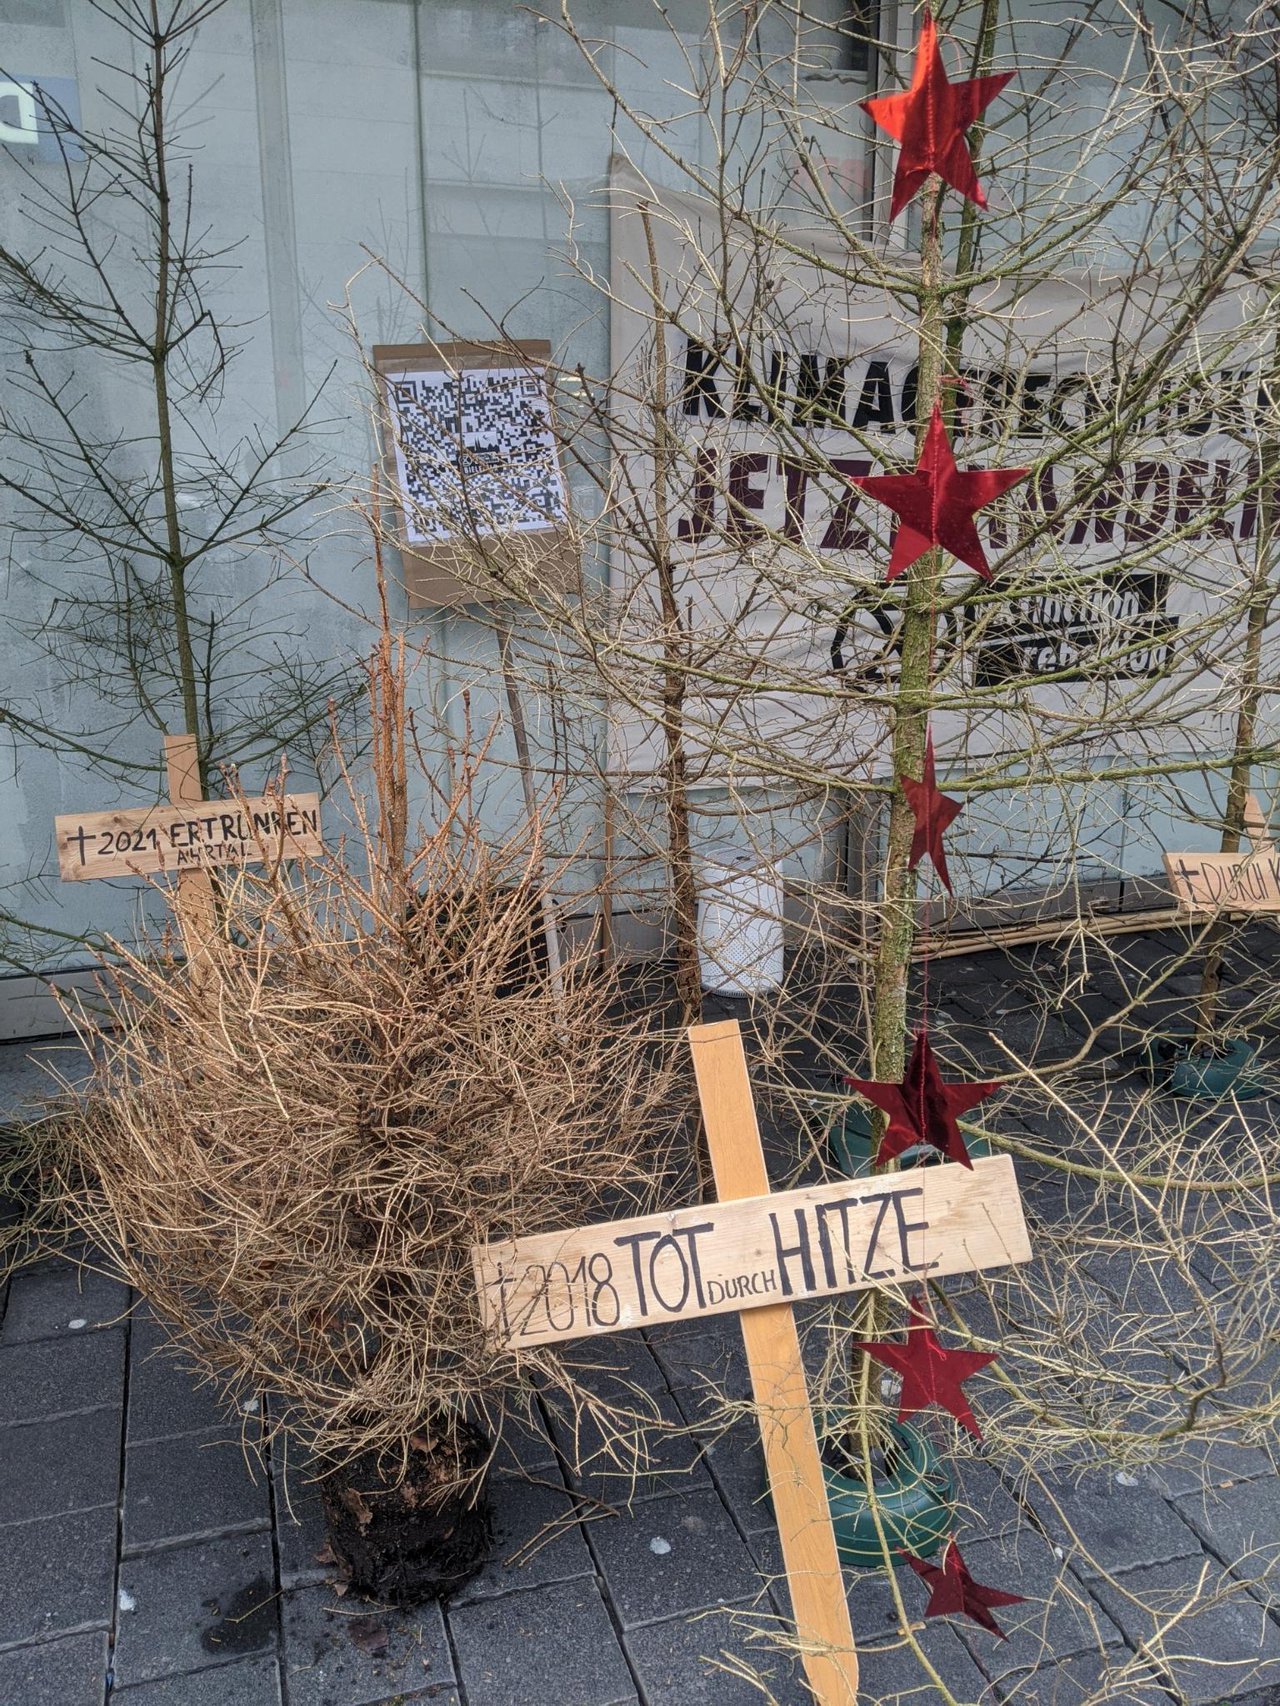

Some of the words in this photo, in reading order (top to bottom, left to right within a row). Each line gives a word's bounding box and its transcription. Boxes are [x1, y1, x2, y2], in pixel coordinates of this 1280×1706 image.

[677, 447, 926, 551] JETZ
[97, 828, 158, 856] 2021
[519, 1252, 621, 1337] 2018
[613, 1221, 715, 1317] TOT
[706, 1268, 778, 1306] DURCH
[768, 1186, 941, 1297] HITZE
